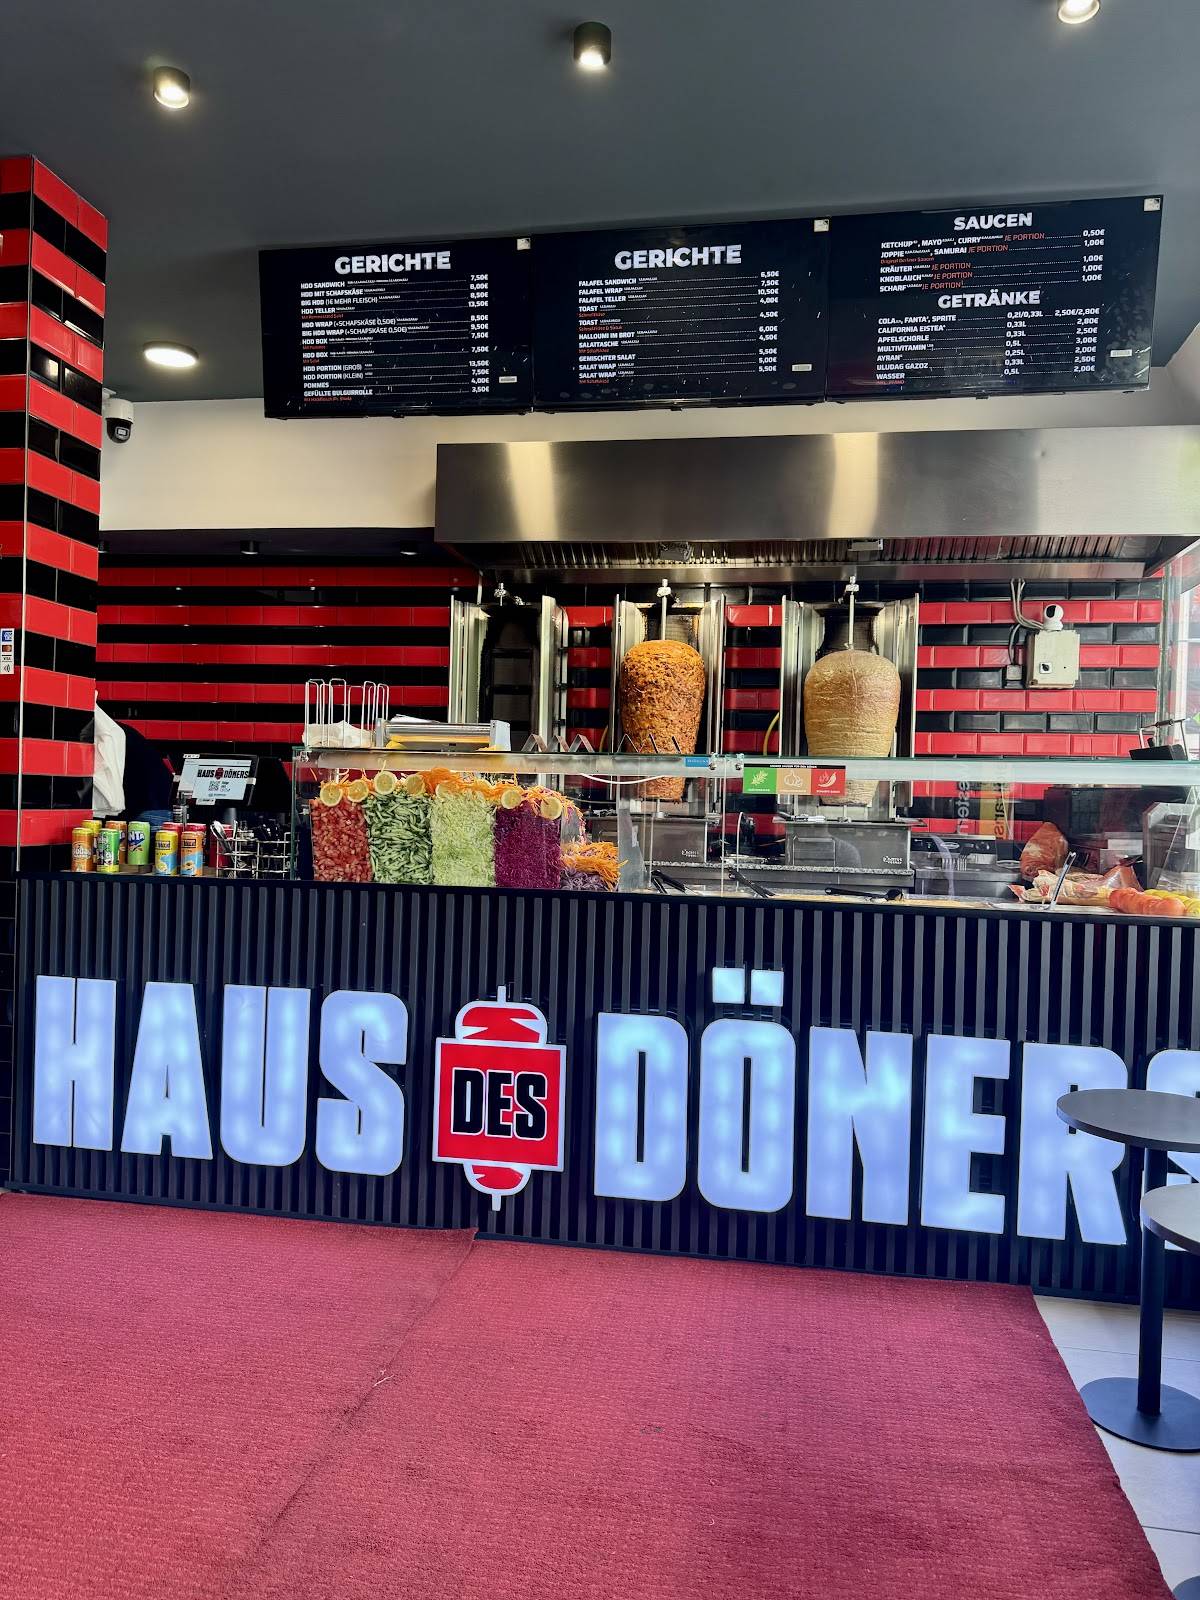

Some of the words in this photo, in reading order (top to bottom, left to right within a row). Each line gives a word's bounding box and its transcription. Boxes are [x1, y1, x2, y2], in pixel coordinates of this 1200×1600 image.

[954, 213, 1032, 231] SAUCEN
[1083, 229, 1105, 237] 0,50€
[934, 247, 967, 255] SAMURAI
[1084, 239, 1104, 247] 1,00€
[614, 244, 741, 270] GERICHTE
[1083, 255, 1103, 263] 1,00€
[335, 251, 451, 274] GERICHTE
[1081, 274, 1102, 282] 1,00€
[313, 281, 345, 289] SANDWICH
[579, 279, 604, 287] FALAFEL
[325, 288, 363, 297] SCHAFSKÄSE
[938, 289, 1040, 309] GETRÄNKE
[470, 323, 489, 331] 9,50€
[878, 326, 918, 334] CALIFORNIA
[1077, 317, 1099, 325] 2,80€
[878, 335, 930, 343] APFELSCHORLE
[579, 354, 616, 362] GEMISCHTER
[1074, 365, 1095, 373] 2,00€
[197, 769, 215, 778] HAUS
[224, 768, 249, 778] DÖNERS
[33, 975, 409, 1176] HAUS
[450, 1067, 548, 1140] DES
